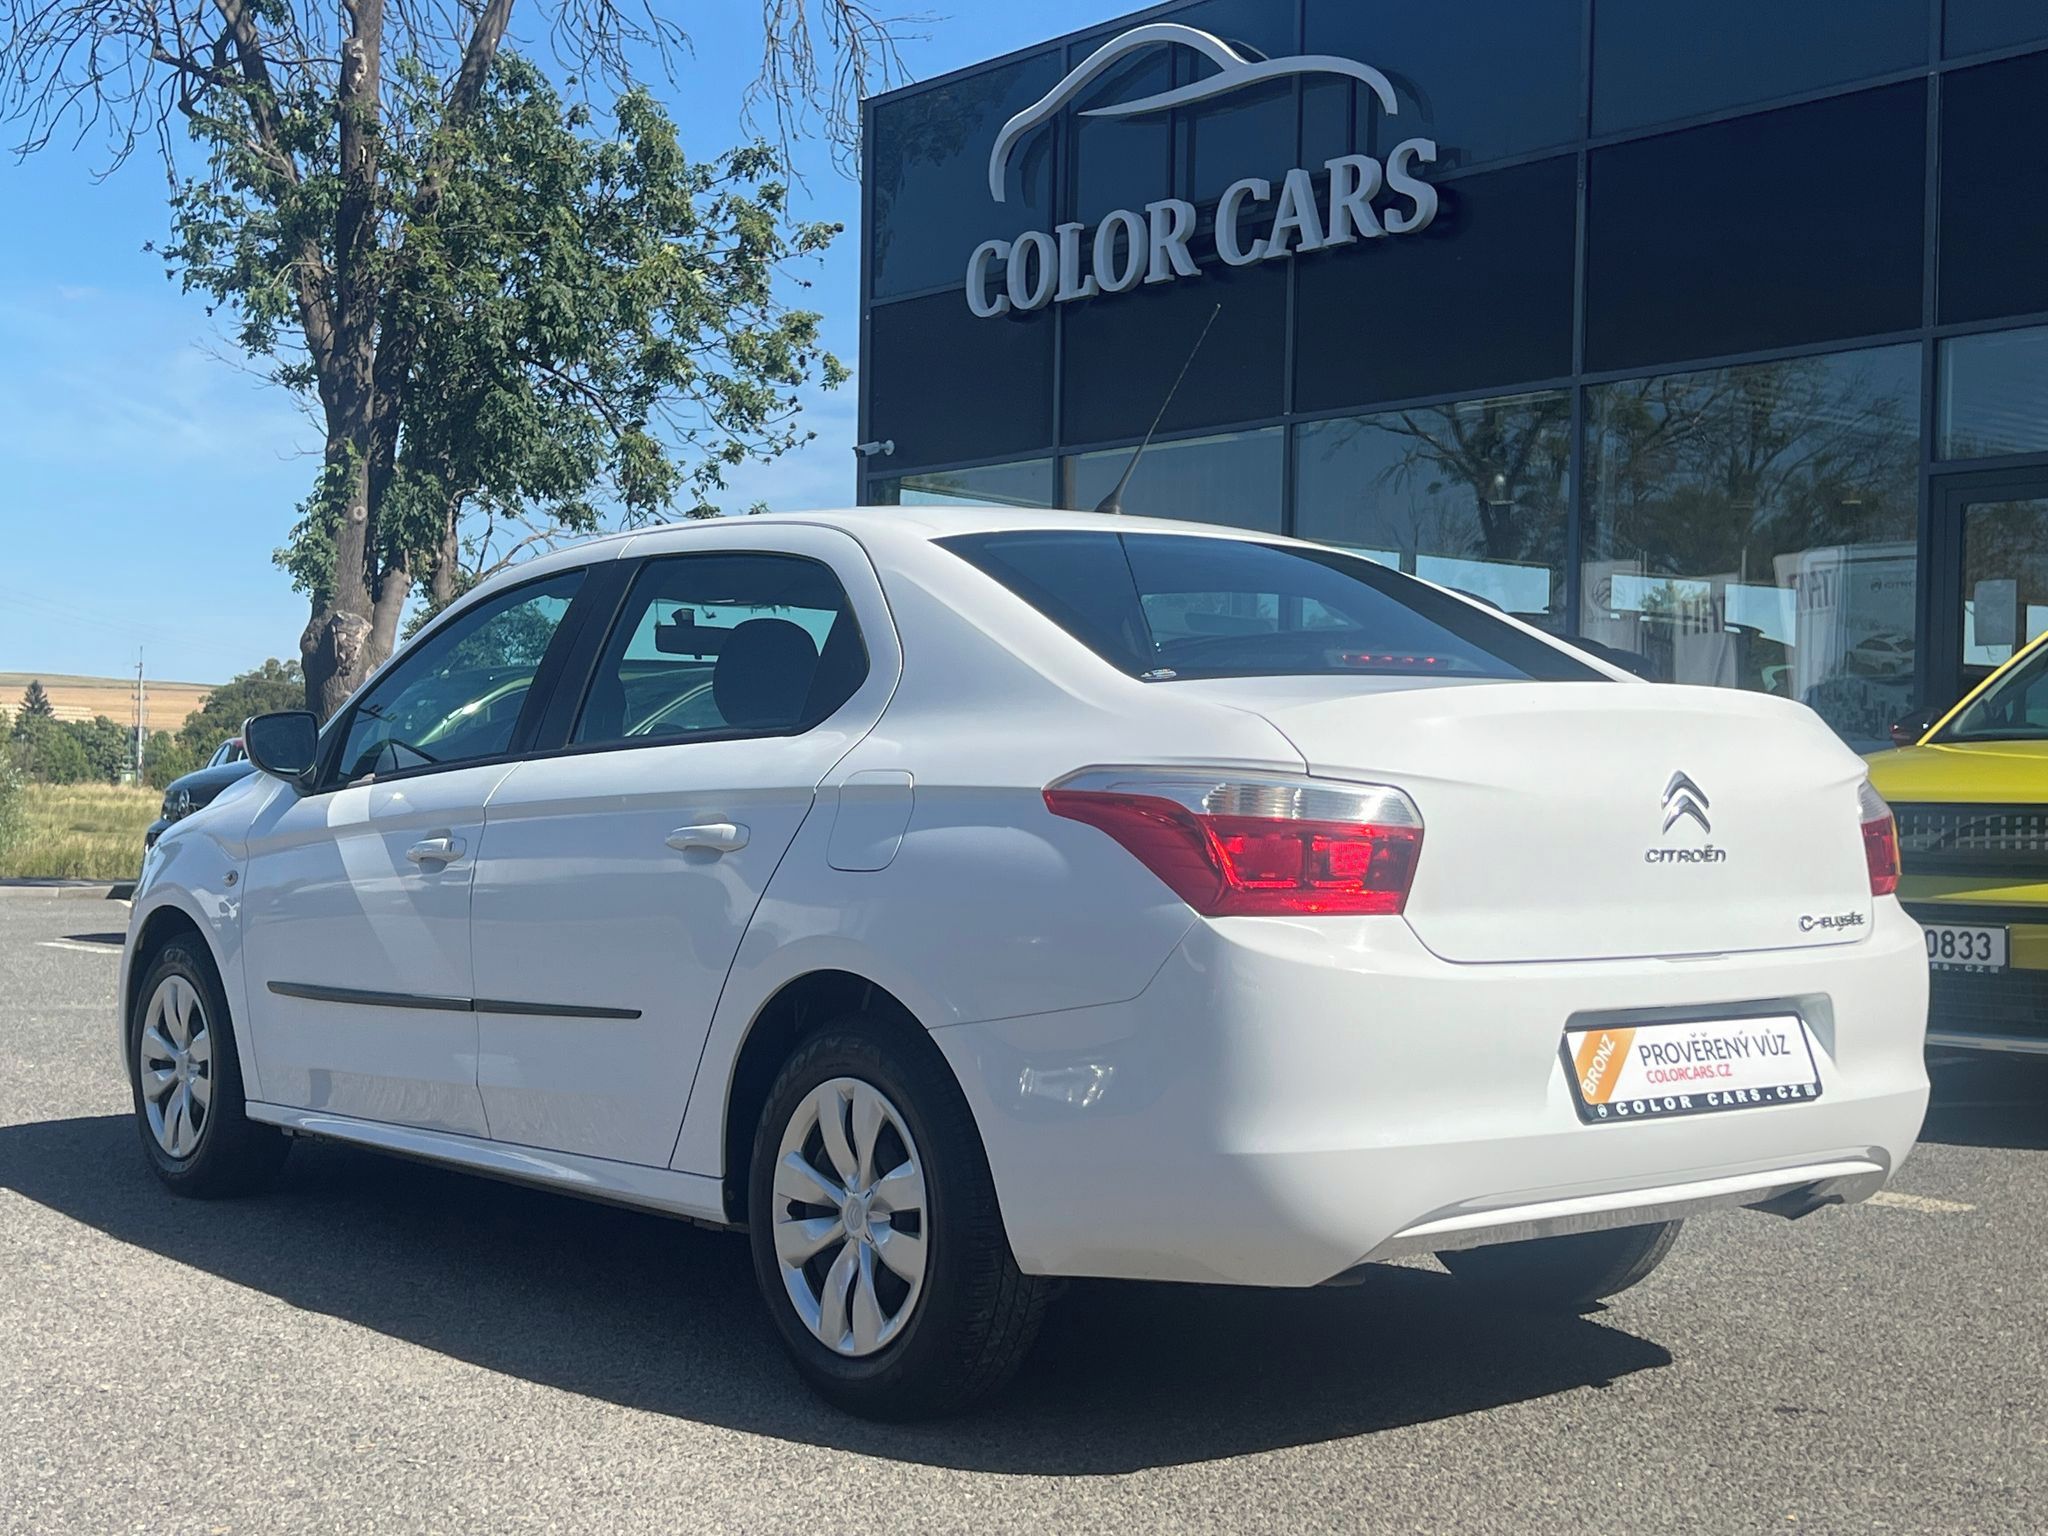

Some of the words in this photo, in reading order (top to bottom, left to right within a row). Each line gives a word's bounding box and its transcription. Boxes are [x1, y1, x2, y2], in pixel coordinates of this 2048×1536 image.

[966, 198, 1202, 318] COLOR
[1215, 137, 1438, 267] CARS
[1644, 843, 1727, 863] CITROËN
[1925, 929, 1991, 961] 0833
[1638, 1030, 1751, 1067] PROVĚŘENÝ
[1752, 1028, 1791, 1056] VŮZ
[1582, 1033, 1616, 1096] BRONZ
[1646, 1063, 1733, 1084] COLORCARS.CZ
[1616, 1095, 1693, 1116] COLOR
[1707, 1084, 1801, 1106] CARS.CZ
